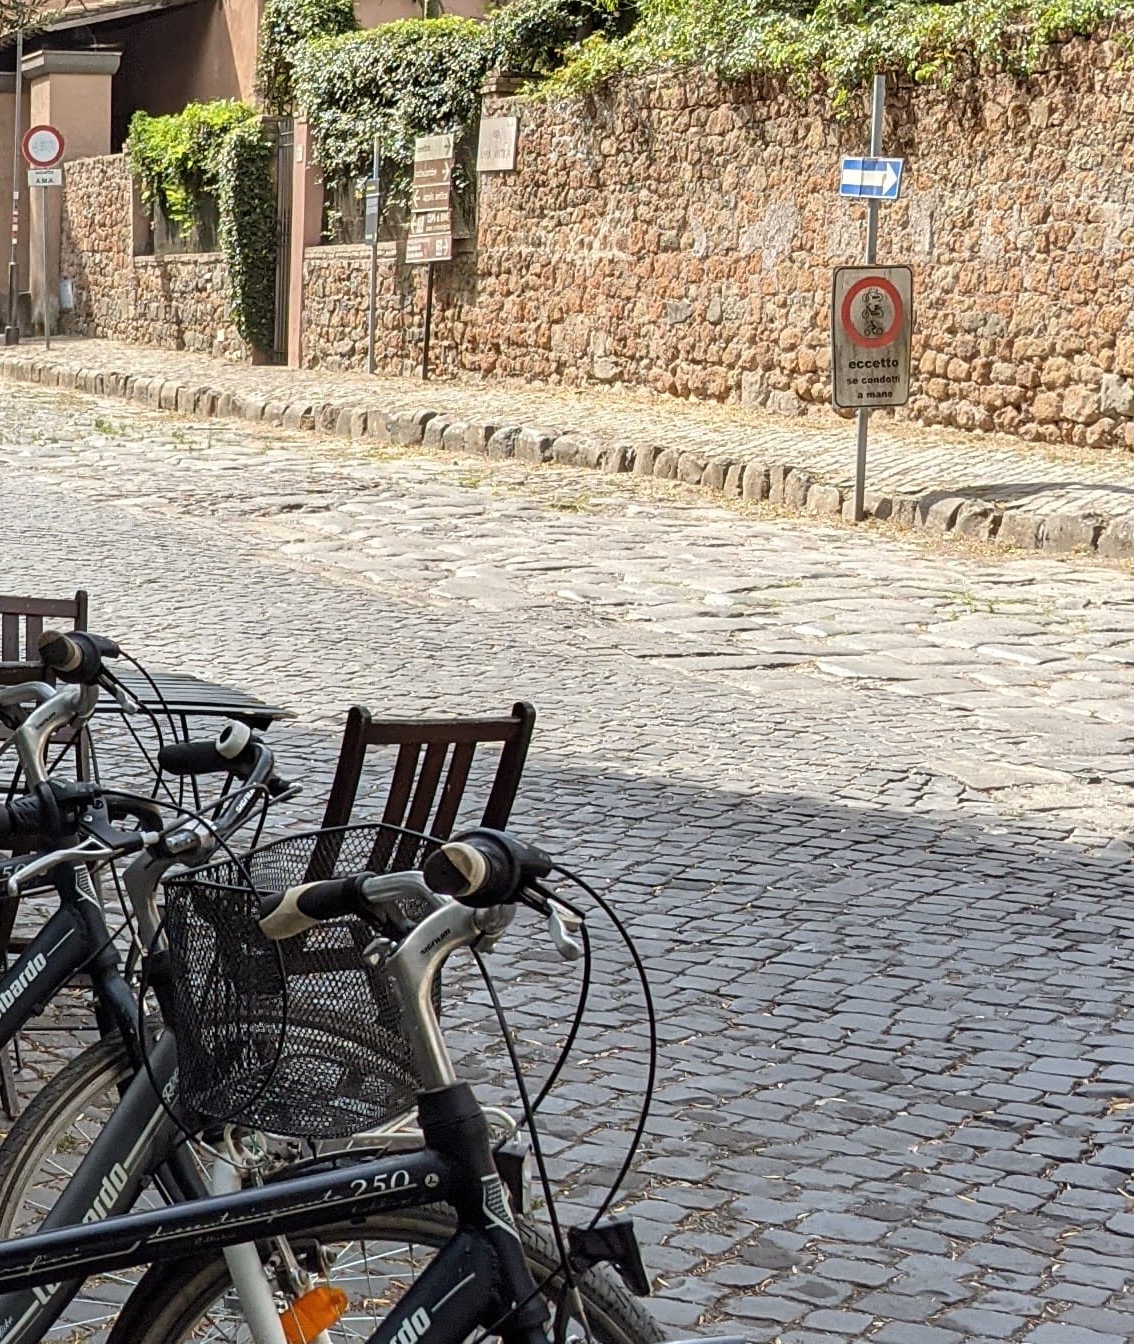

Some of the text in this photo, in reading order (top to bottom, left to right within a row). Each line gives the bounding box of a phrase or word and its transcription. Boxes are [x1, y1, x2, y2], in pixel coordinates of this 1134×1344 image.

[849, 359, 899, 369] eccetto
[847, 375, 900, 386] se condotti
[857, 390, 893, 399] a mano
[350, 1169, 410, 1197] 250
